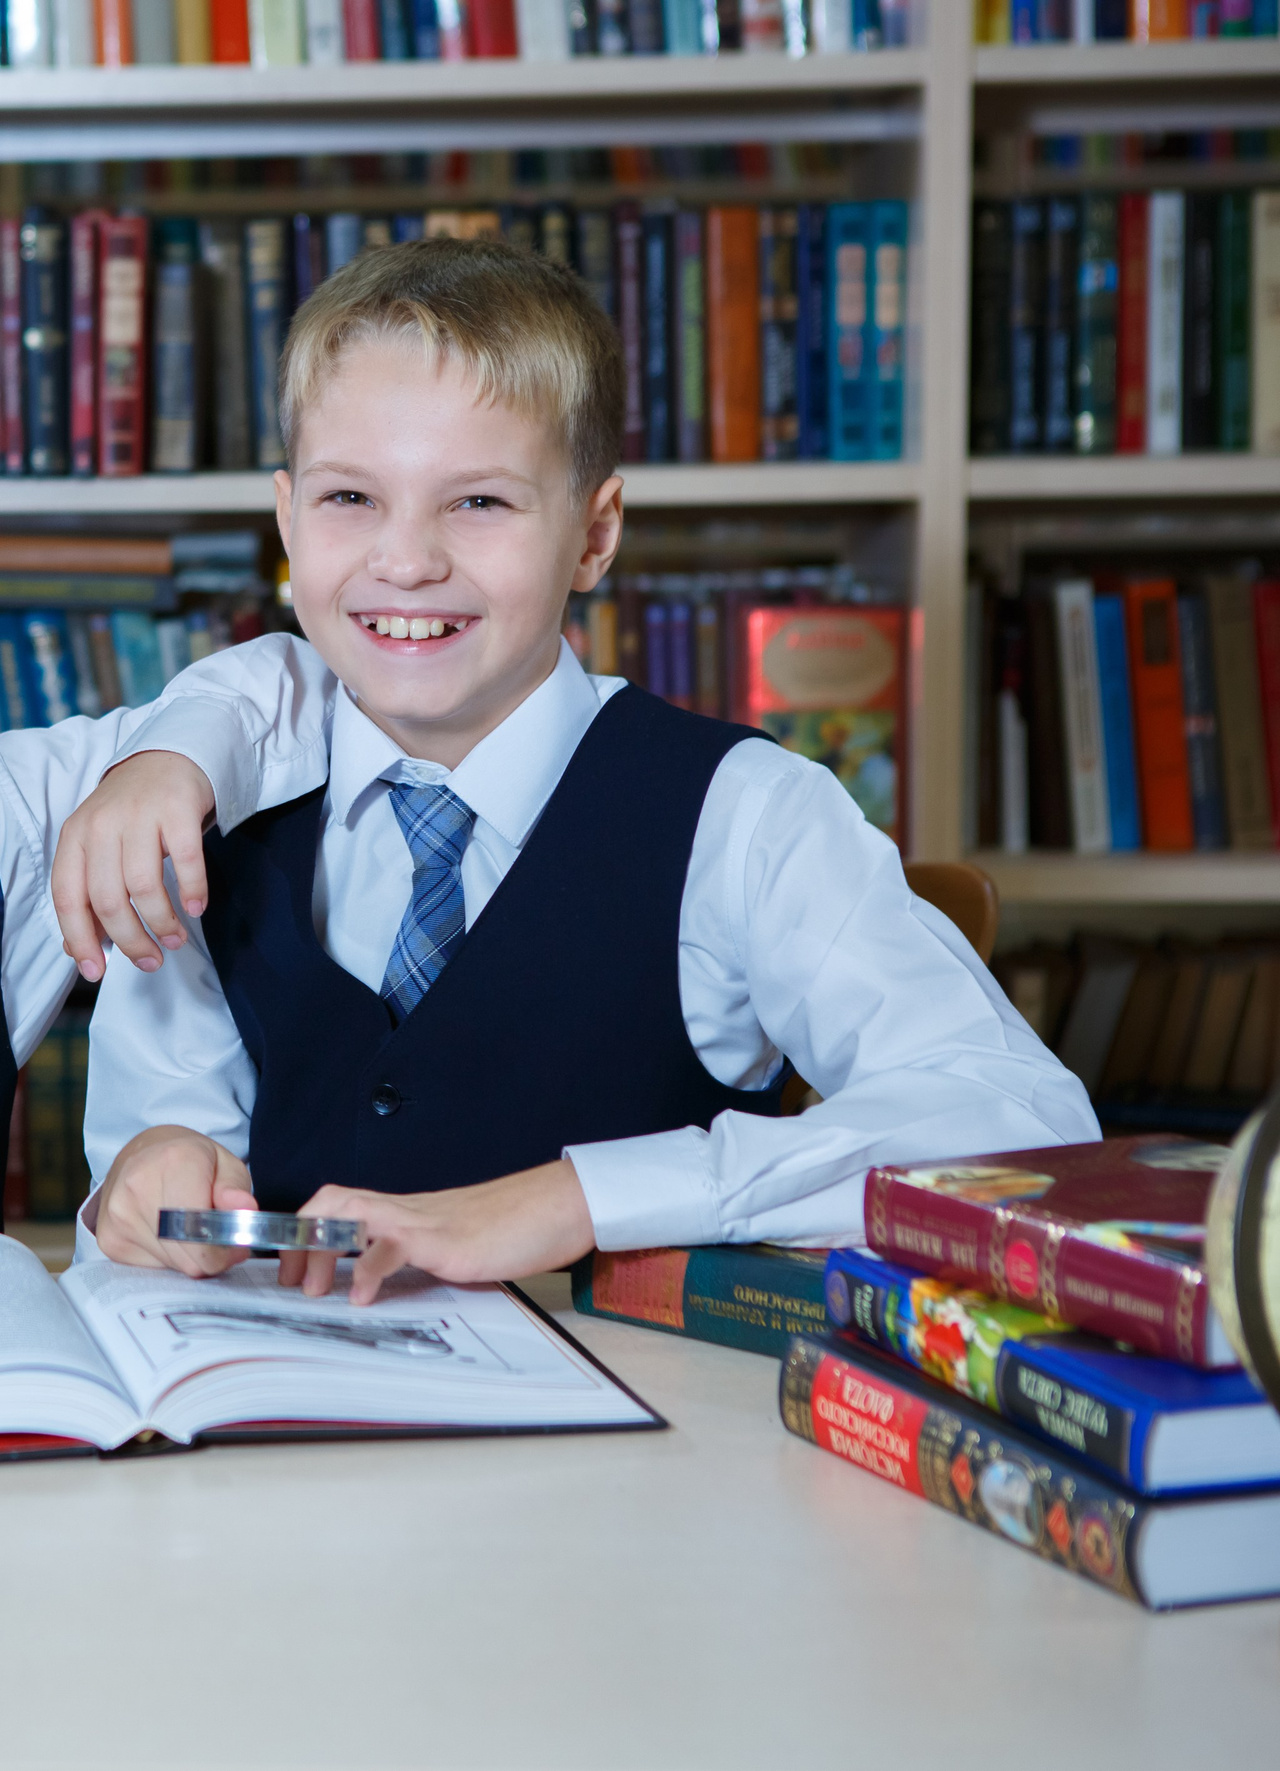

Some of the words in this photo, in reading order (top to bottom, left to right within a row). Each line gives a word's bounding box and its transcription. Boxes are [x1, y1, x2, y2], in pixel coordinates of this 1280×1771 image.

[733, 1283, 826, 1322] ПРЕКРАСНОГО
[842, 1374, 895, 1425] ФЛОТА
[816, 1394, 910, 1463] РОССИЙСКОГО
[827, 1425, 907, 1487] ИСТОРИЯ
